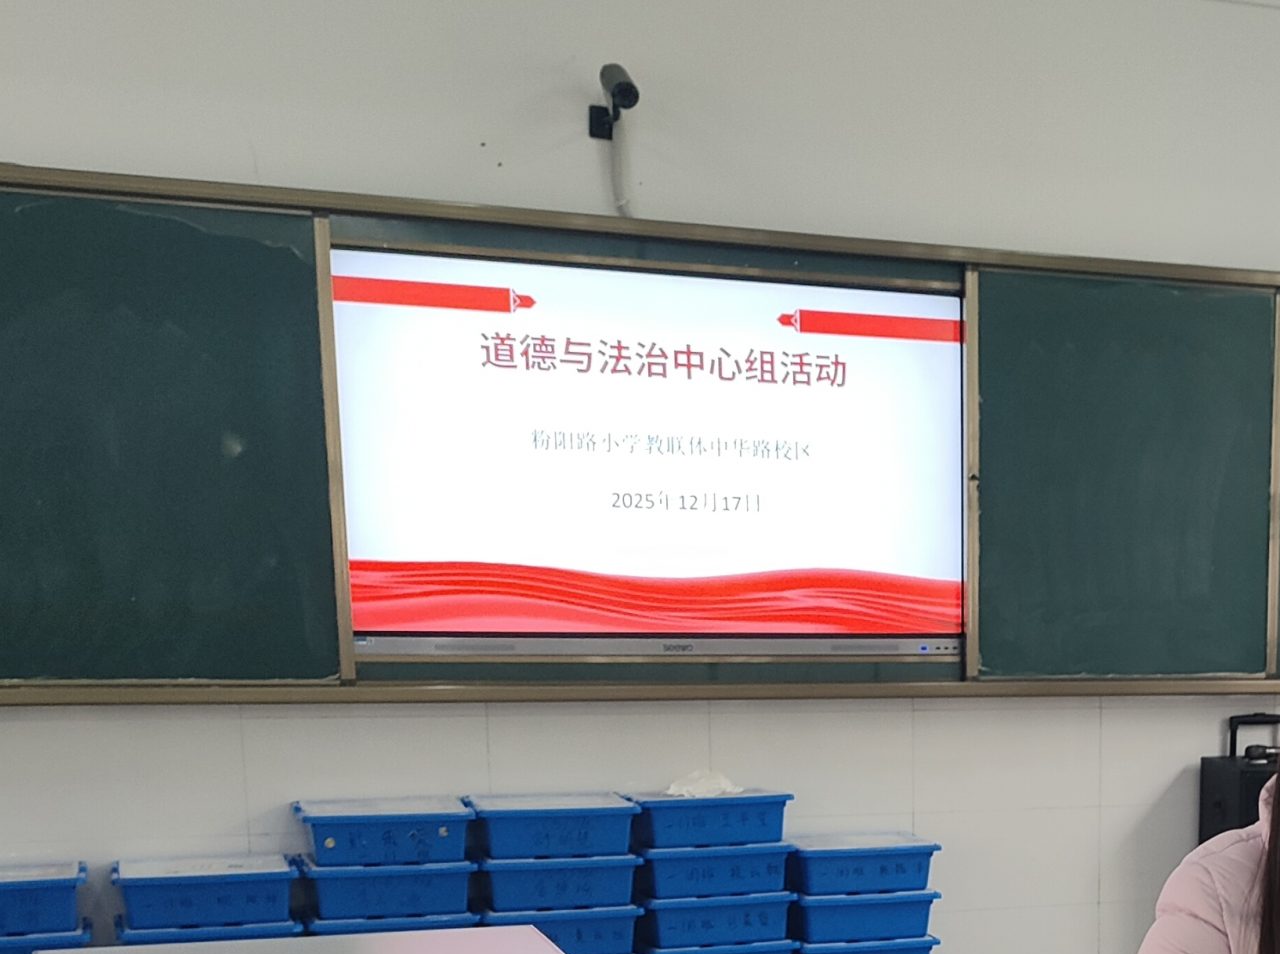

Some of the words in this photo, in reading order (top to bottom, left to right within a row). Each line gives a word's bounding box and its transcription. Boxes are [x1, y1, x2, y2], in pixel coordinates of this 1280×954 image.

[480, 332, 848, 388] 道德与法治中心组活动
